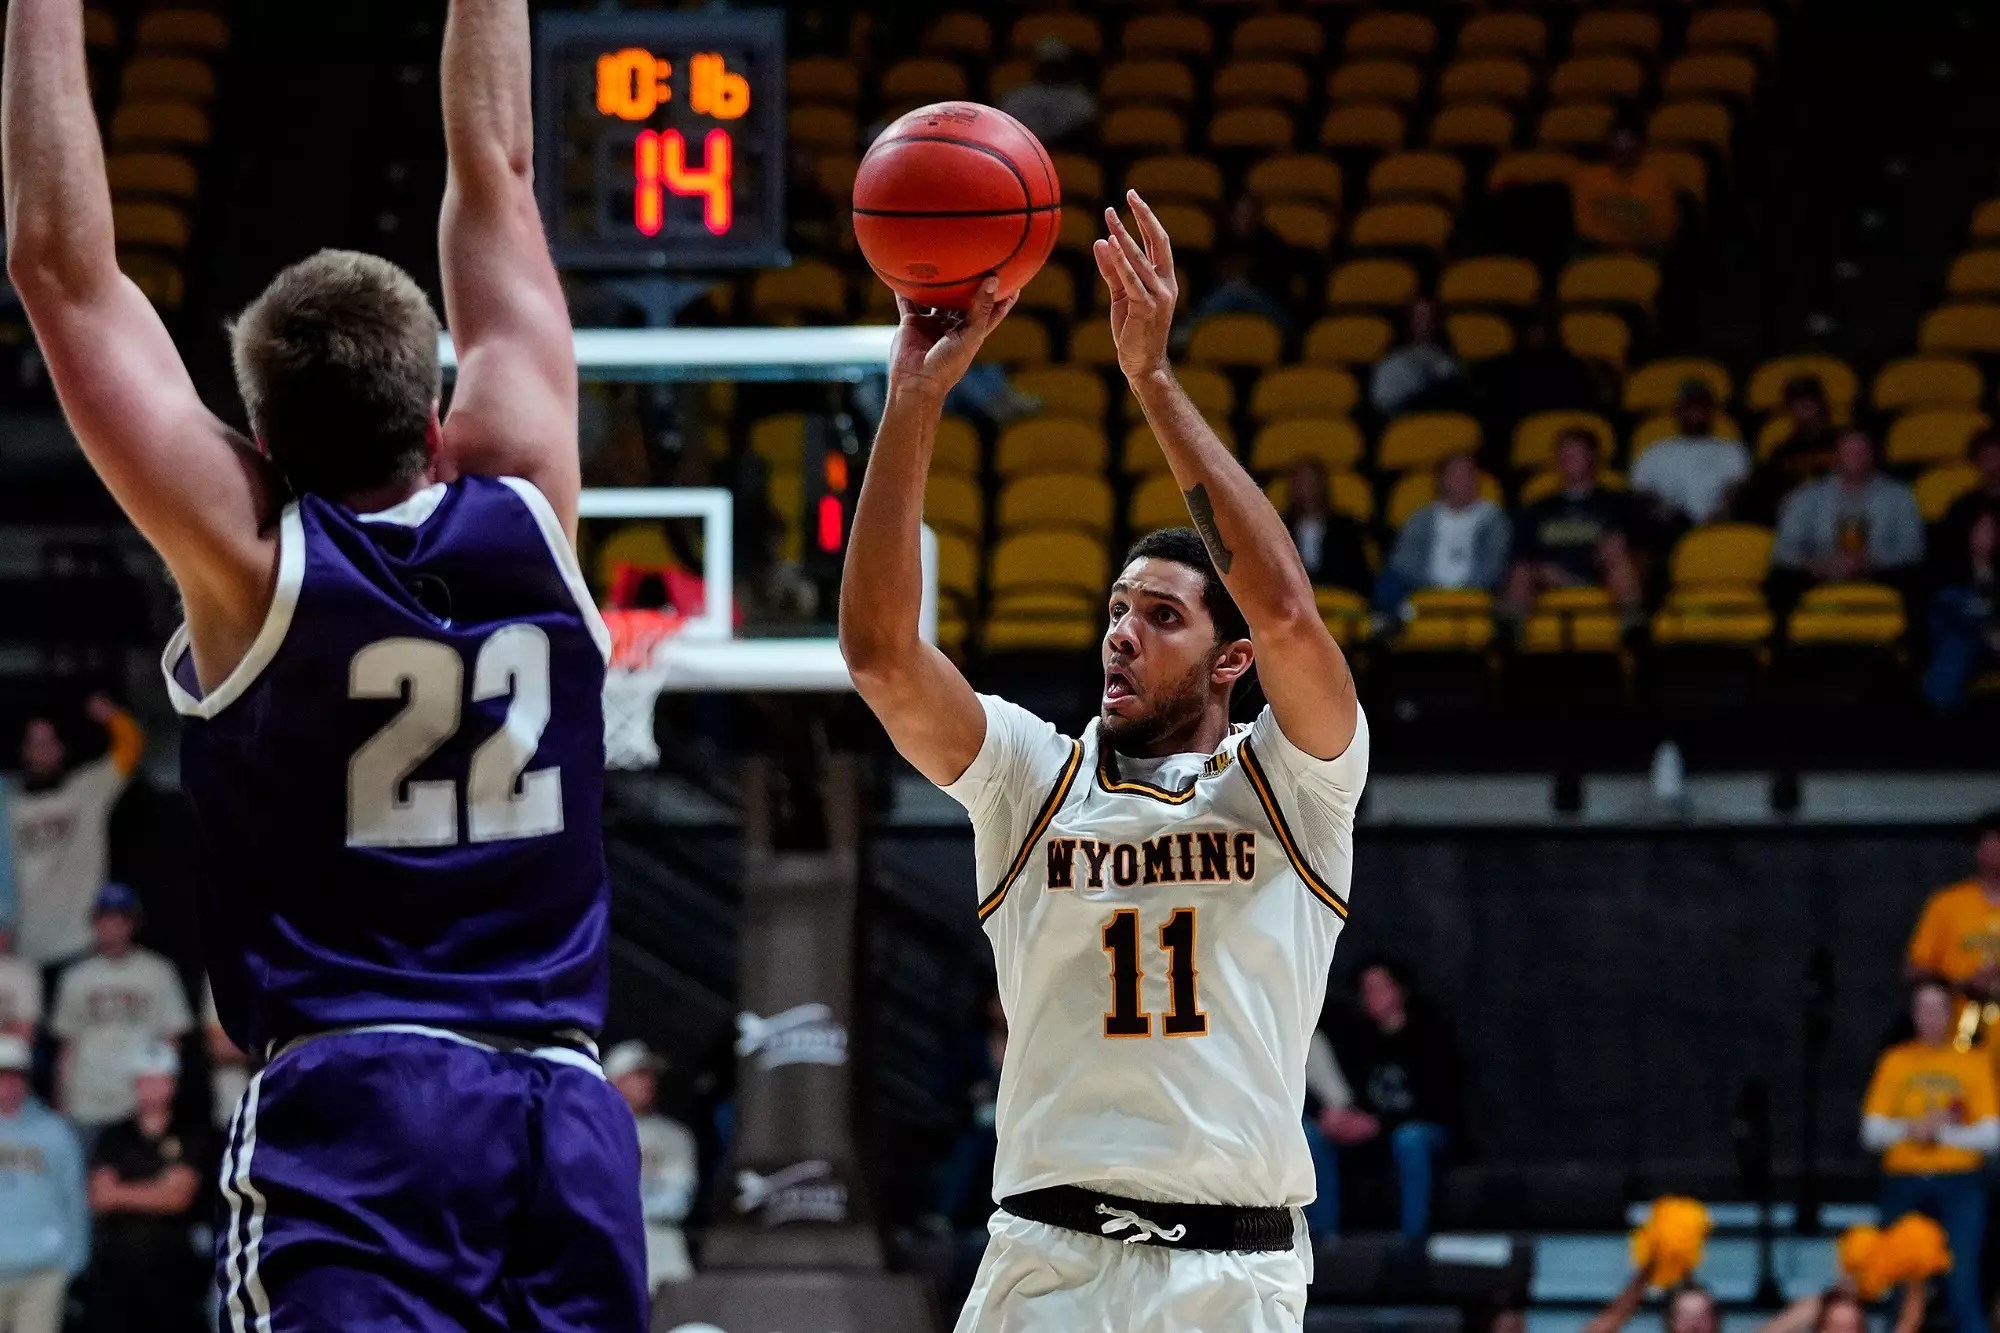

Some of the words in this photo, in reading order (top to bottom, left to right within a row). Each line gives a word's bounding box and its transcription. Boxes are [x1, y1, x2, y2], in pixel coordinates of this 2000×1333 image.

[635, 128, 732, 236] 14
[346, 623, 565, 848] 22
[1046, 829, 1257, 892] WYOMING
[1102, 907, 1208, 1038] 11
